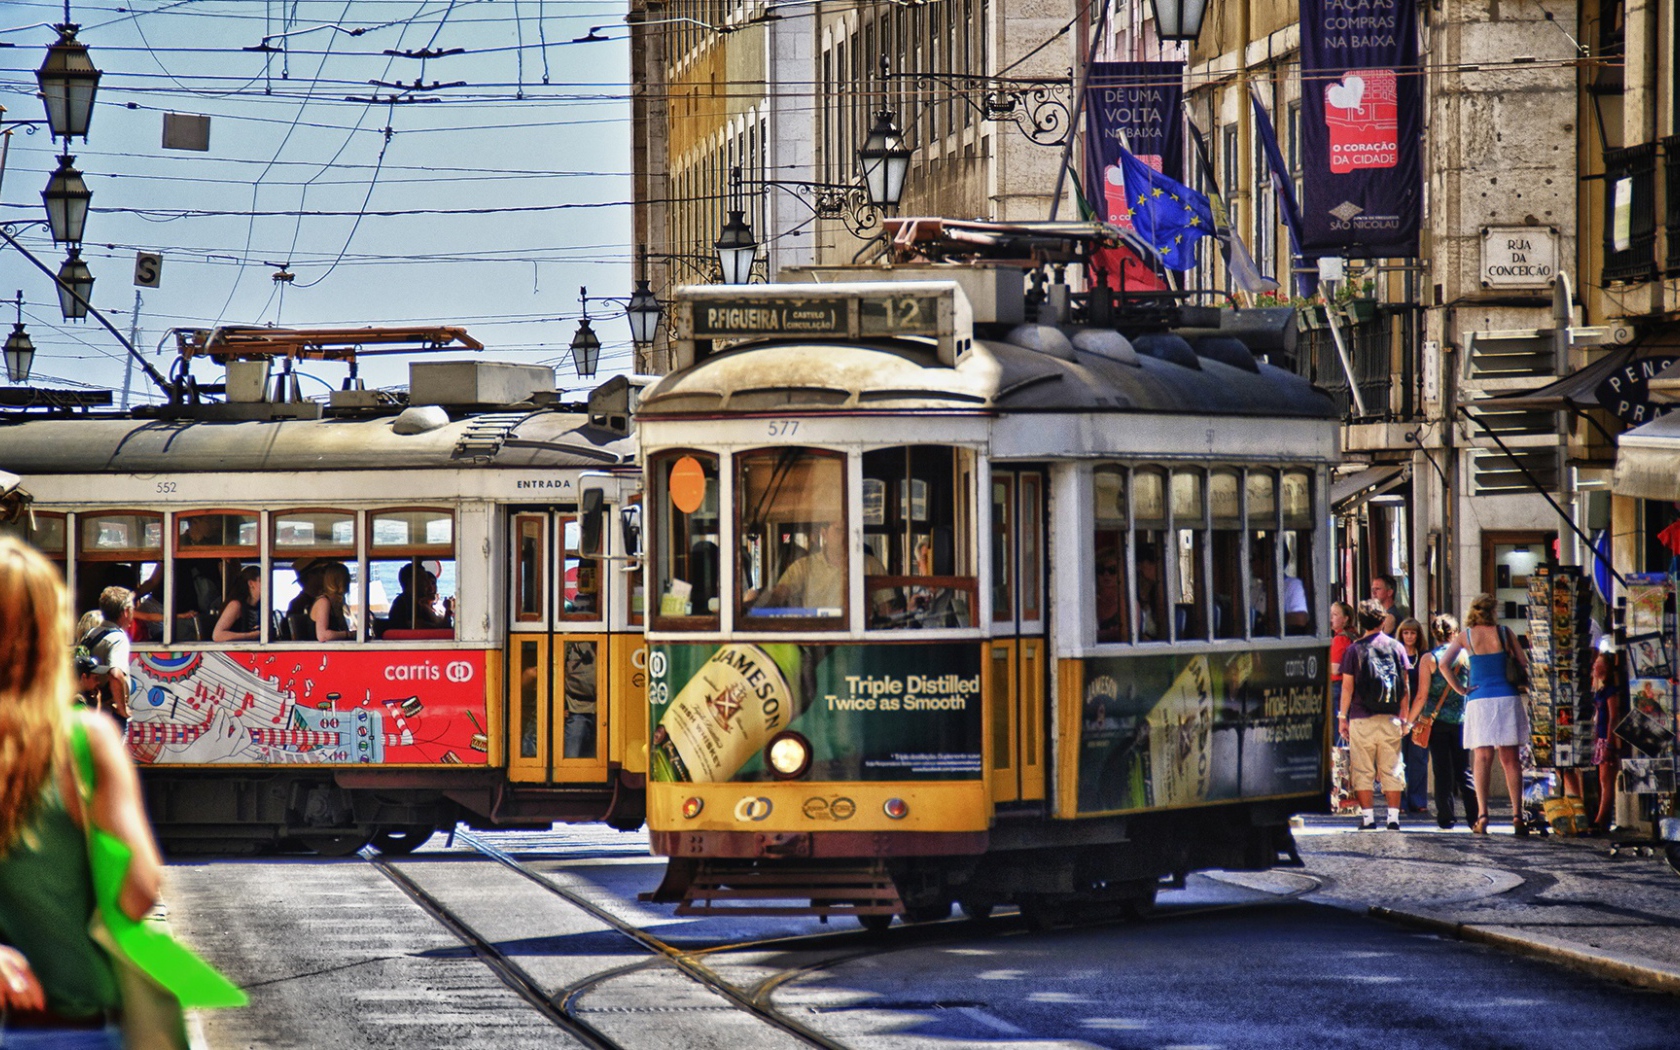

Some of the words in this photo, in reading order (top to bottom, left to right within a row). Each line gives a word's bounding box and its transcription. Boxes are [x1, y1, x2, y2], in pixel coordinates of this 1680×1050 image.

[1324, 0, 1370, 13] FAÇA
[1373, 0, 1395, 9] AS
[1324, 15, 1396, 30] COMPRAS
[1325, 36, 1348, 48] NA
[1351, 35, 1396, 48] BAIXA
[1105, 88, 1125, 103] DÊ
[1128, 89, 1163, 103] UMA
[1104, 108, 1163, 123] VOLTA
[1126, 127, 1163, 138] BAIXA
[1332, 144, 1342, 153] O
[1343, 141, 1397, 153] CORAÇÃO
[1332, 154, 1350, 165] DA
[1352, 153, 1396, 164] CIDADE
[1353, 220, 1399, 230] NICOLAU
[1507, 239, 1532, 250] RUA
[1512, 252, 1527, 263] DA
[137, 256, 157, 284] S
[1488, 263, 1551, 277] CONCEIÇÃO
[708, 308, 779, 330] P.FIGUEIRA
[881, 298, 921, 329] 12
[768, 420, 800, 436] 577
[156, 481, 177, 493] 552
[517, 480, 571, 489] ENTRADA
[384, 659, 440, 681] carris
[712, 649, 781, 732] JAMESON
[845, 674, 903, 699] Triple
[906, 674, 980, 694] Distilled
[824, 694, 877, 711] Twice
[879, 697, 900, 711] as
